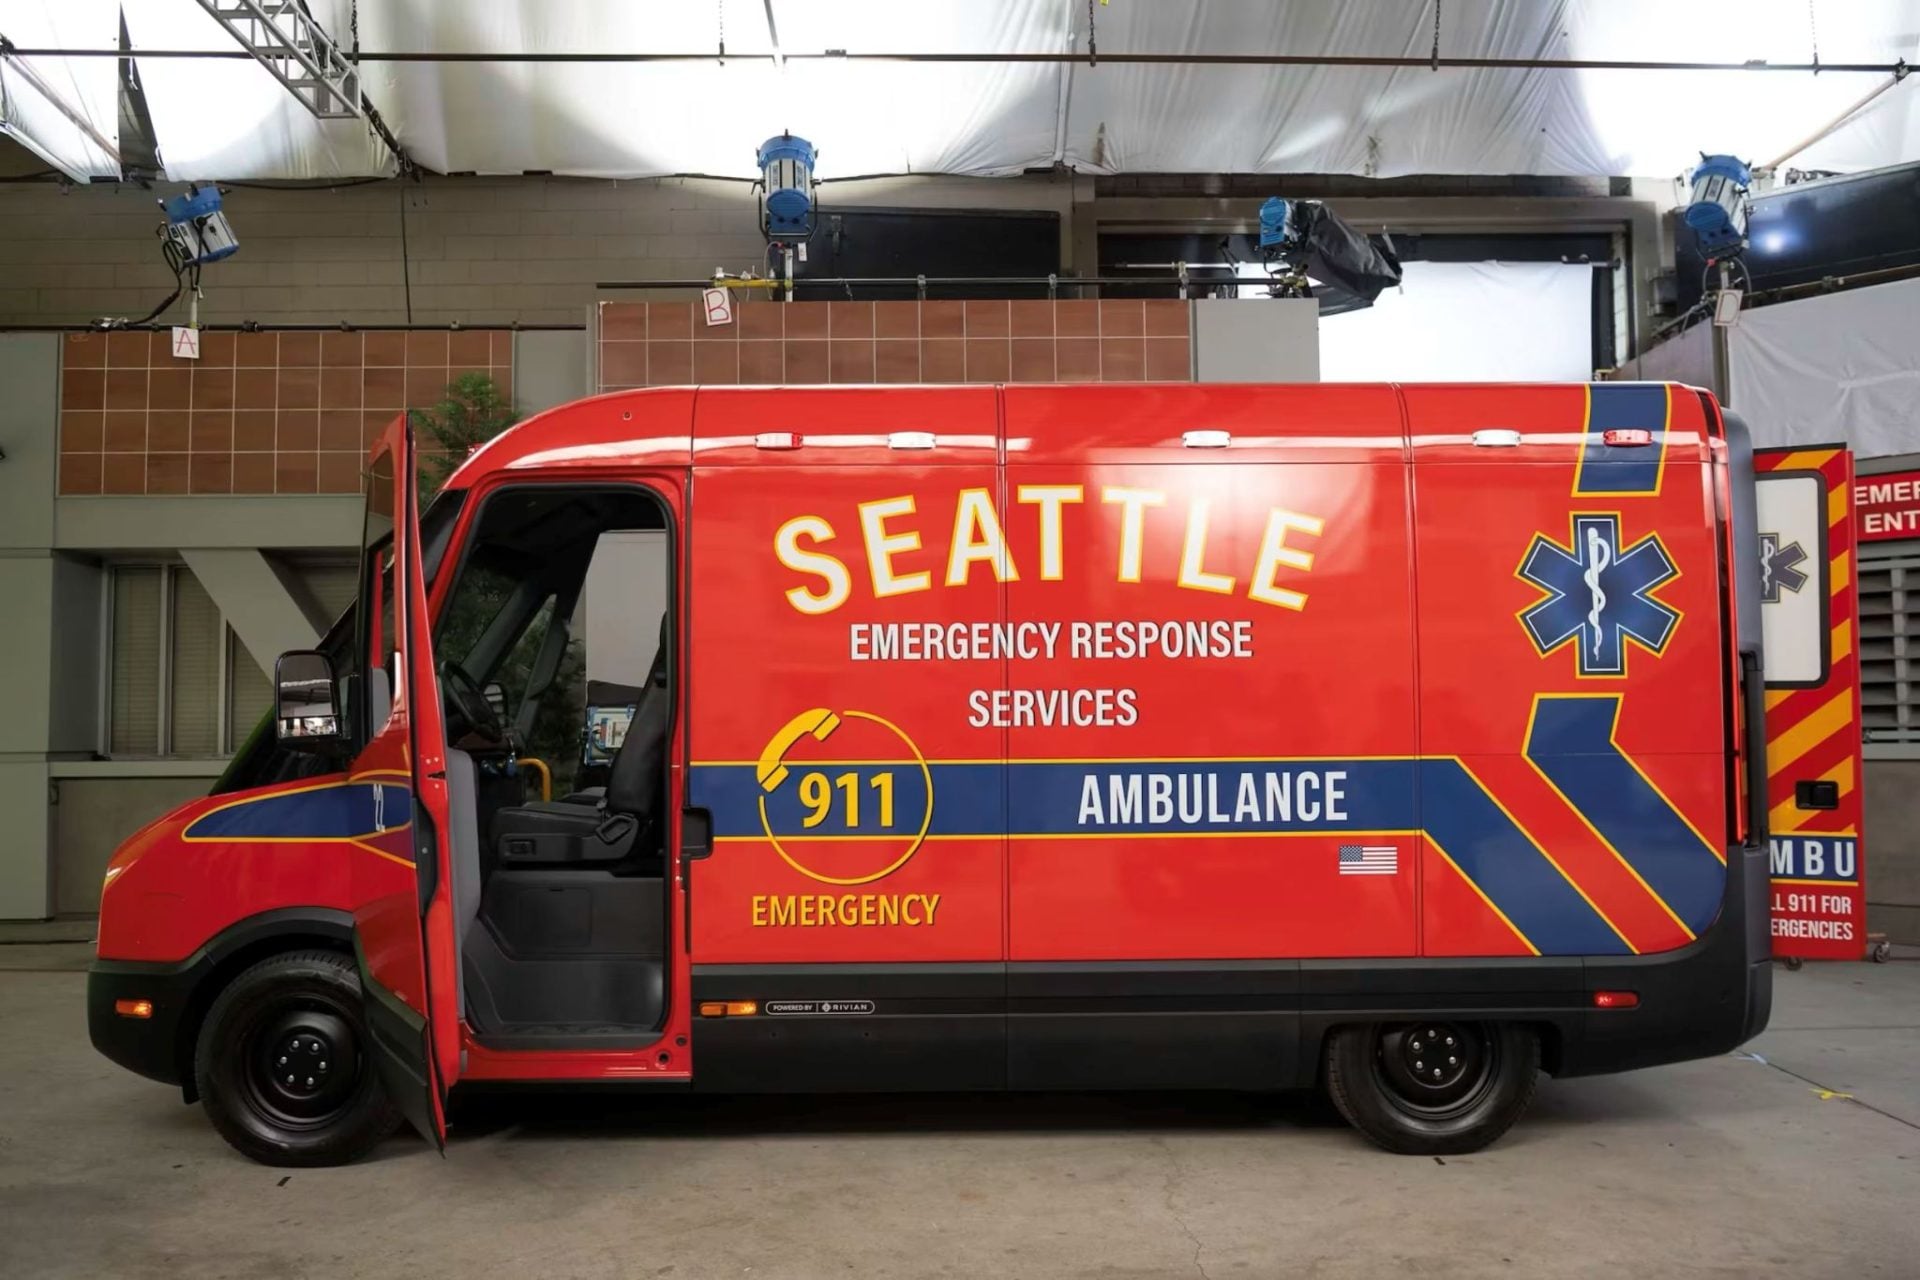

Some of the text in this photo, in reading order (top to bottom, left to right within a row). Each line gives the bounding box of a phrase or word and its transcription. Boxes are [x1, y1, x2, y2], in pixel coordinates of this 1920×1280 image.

[705, 290, 729, 323] B
[175, 329, 196, 355] A
[774, 484, 1323, 614] SEATTLE
[850, 620, 1253, 660] EMERGENCY RESPONSE
[968, 688, 1138, 727] SERVICES
[799, 772, 894, 828] 911
[1077, 771, 1348, 825] AMBULANCE
[752, 893, 941, 926] EMERGENCY
[1788, 894, 1816, 913] 911
[1821, 895, 1852, 914] FOR
